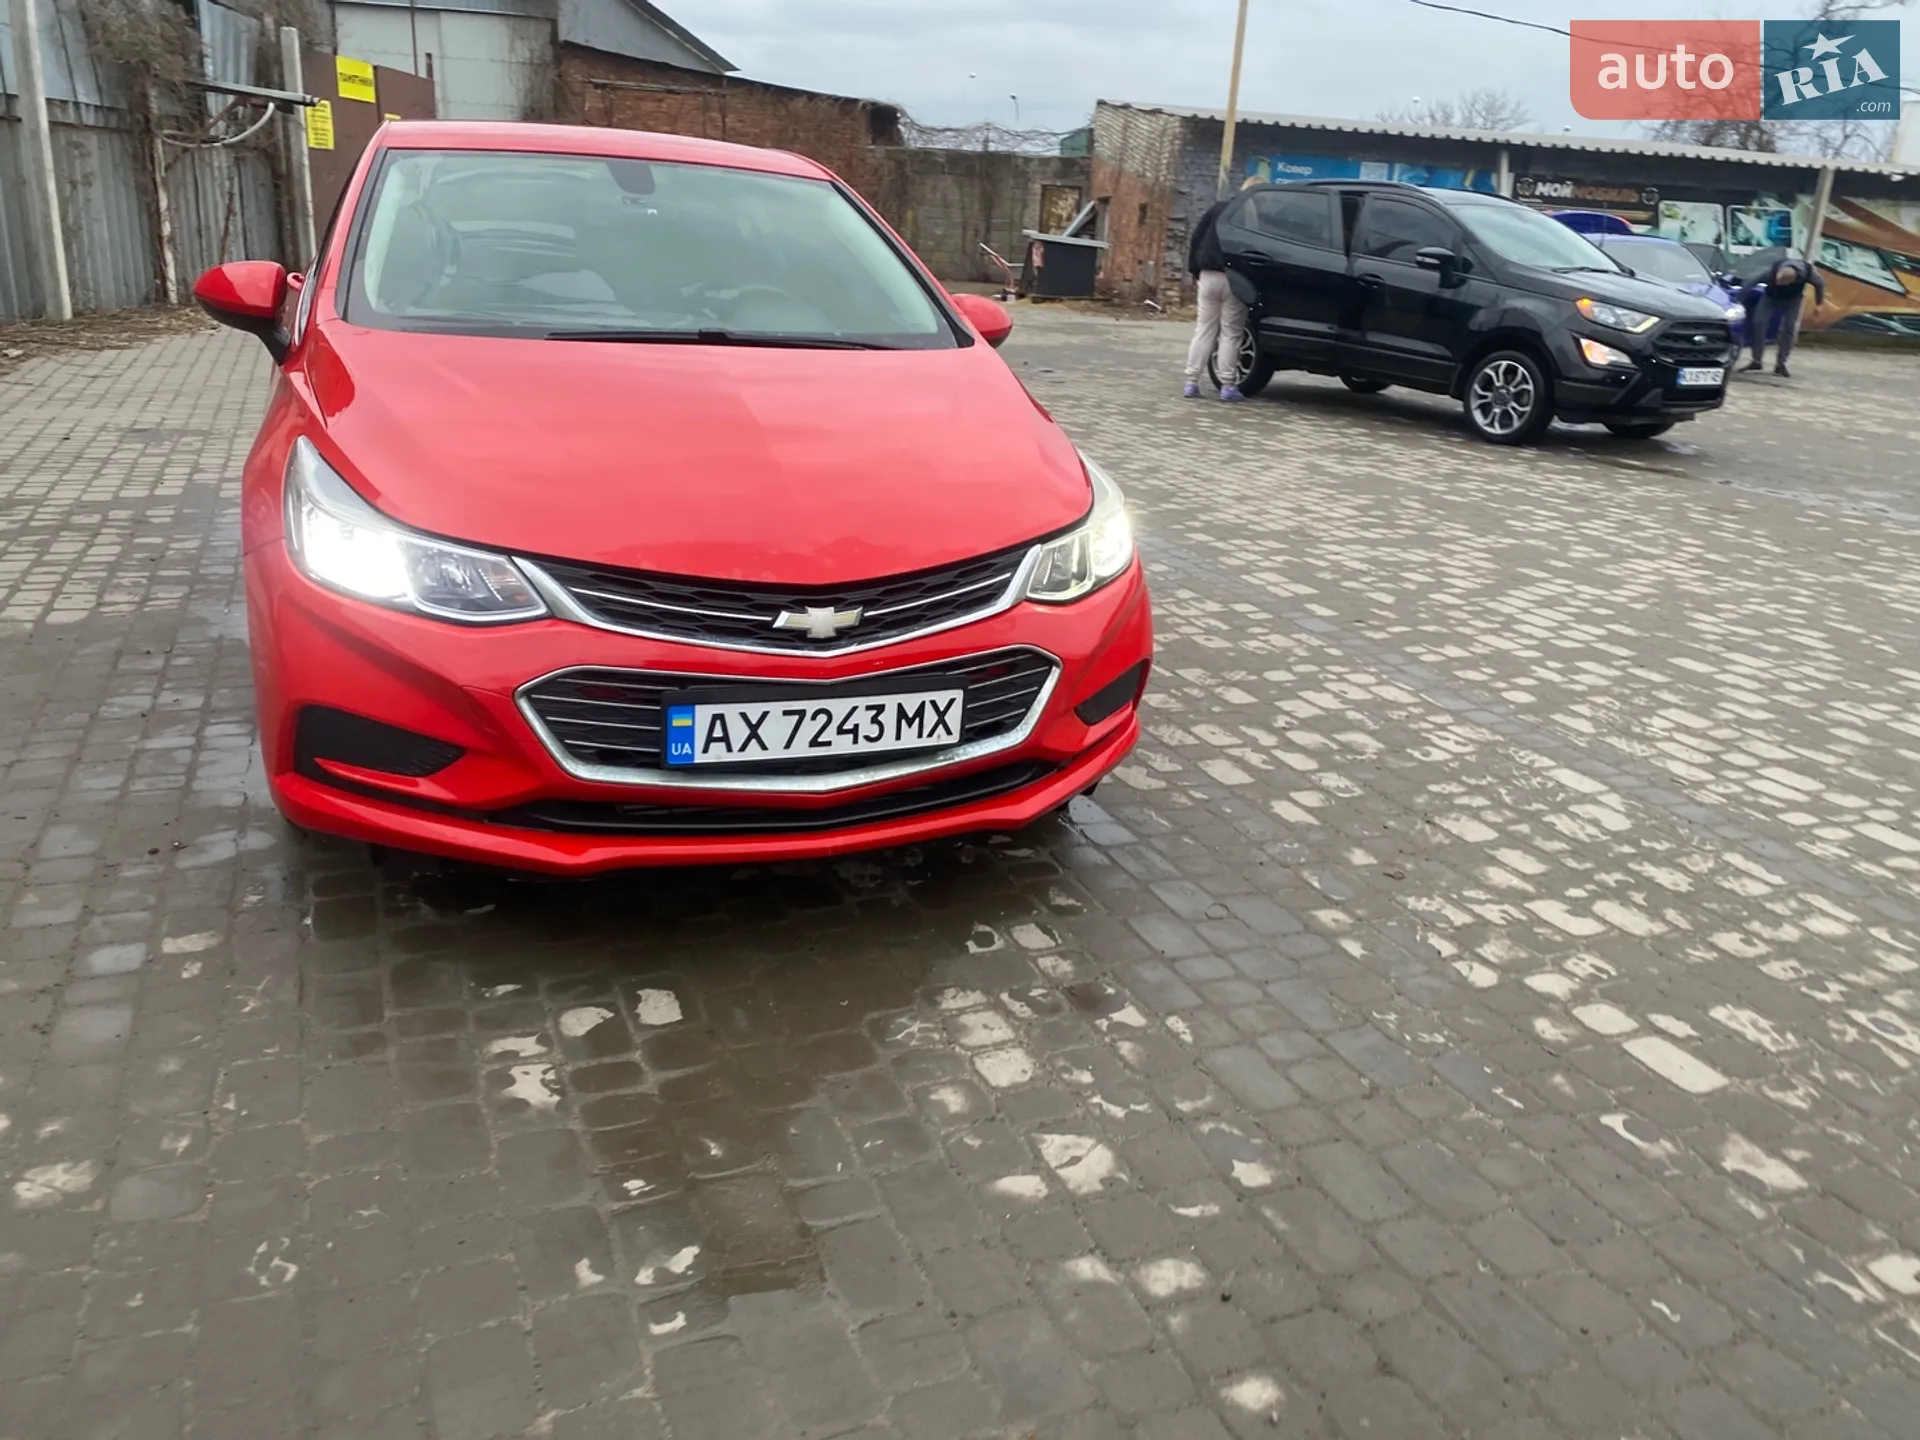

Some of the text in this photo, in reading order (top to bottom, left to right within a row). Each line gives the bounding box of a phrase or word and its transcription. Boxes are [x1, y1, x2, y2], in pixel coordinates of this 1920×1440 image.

[701, 697, 957, 755] AX 7243 MX
[671, 742, 692, 756] UA
